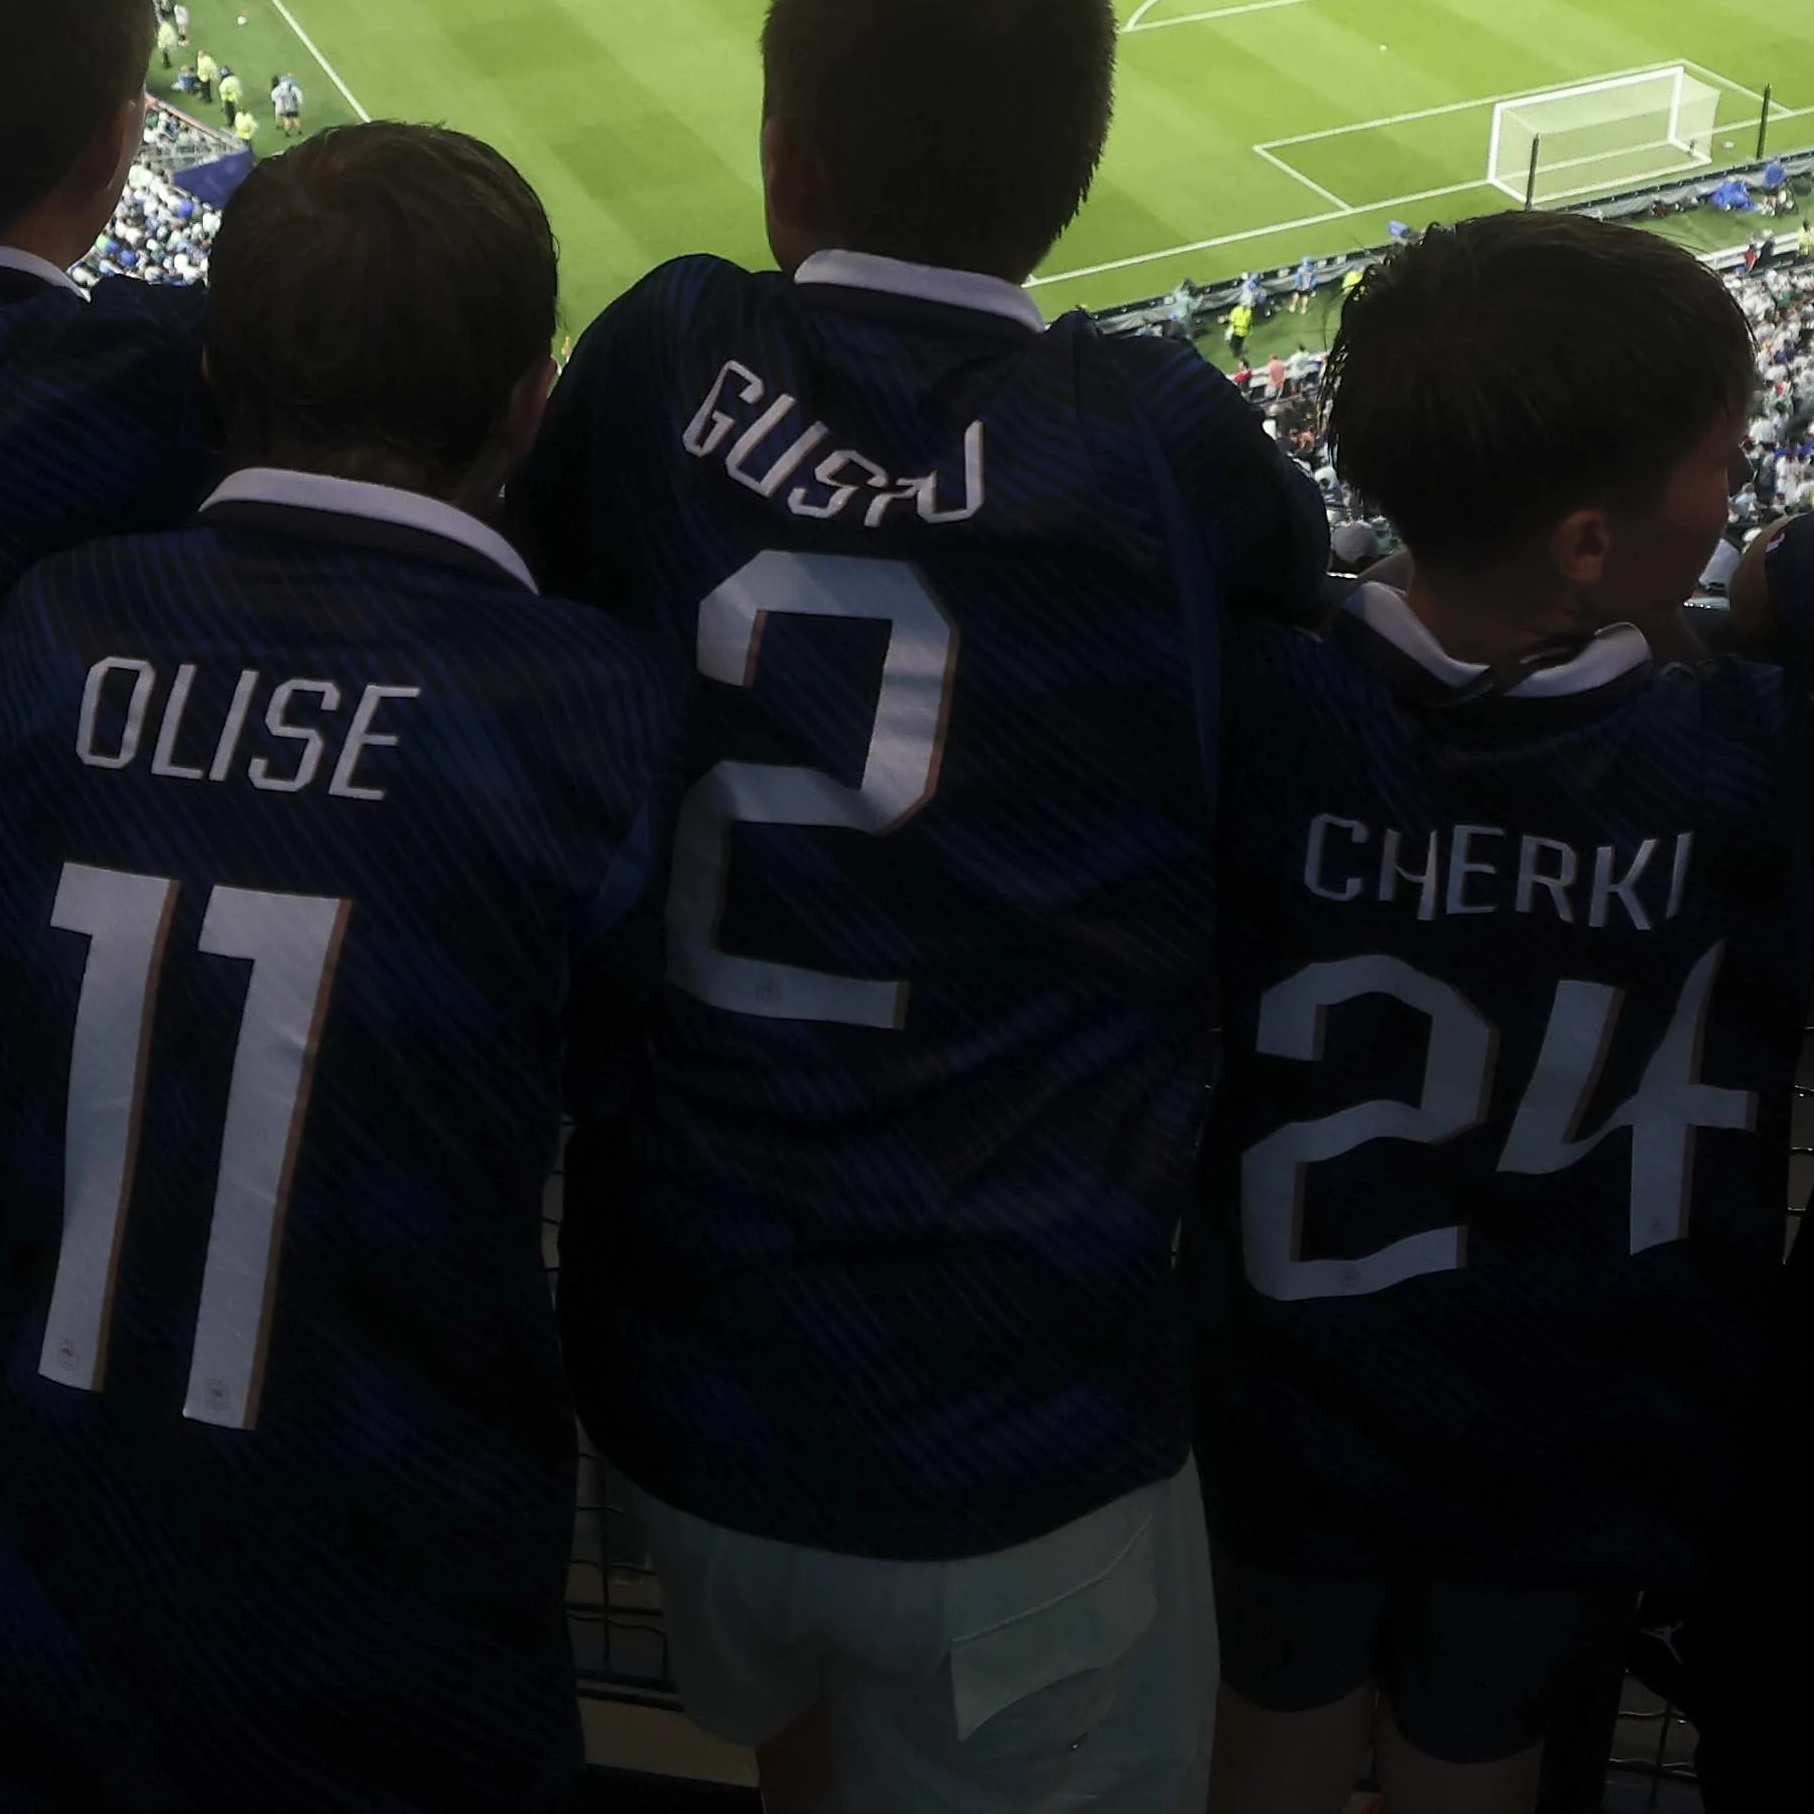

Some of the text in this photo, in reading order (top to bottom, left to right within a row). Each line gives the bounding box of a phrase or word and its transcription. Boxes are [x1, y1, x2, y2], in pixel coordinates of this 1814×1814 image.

[75, 655, 422, 801] OLISE
[665, 548, 962, 1032] 2
[1303, 813, 1693, 932] CHERKI
[37, 860, 354, 1432] 11
[1239, 939, 1756, 1303] 24
